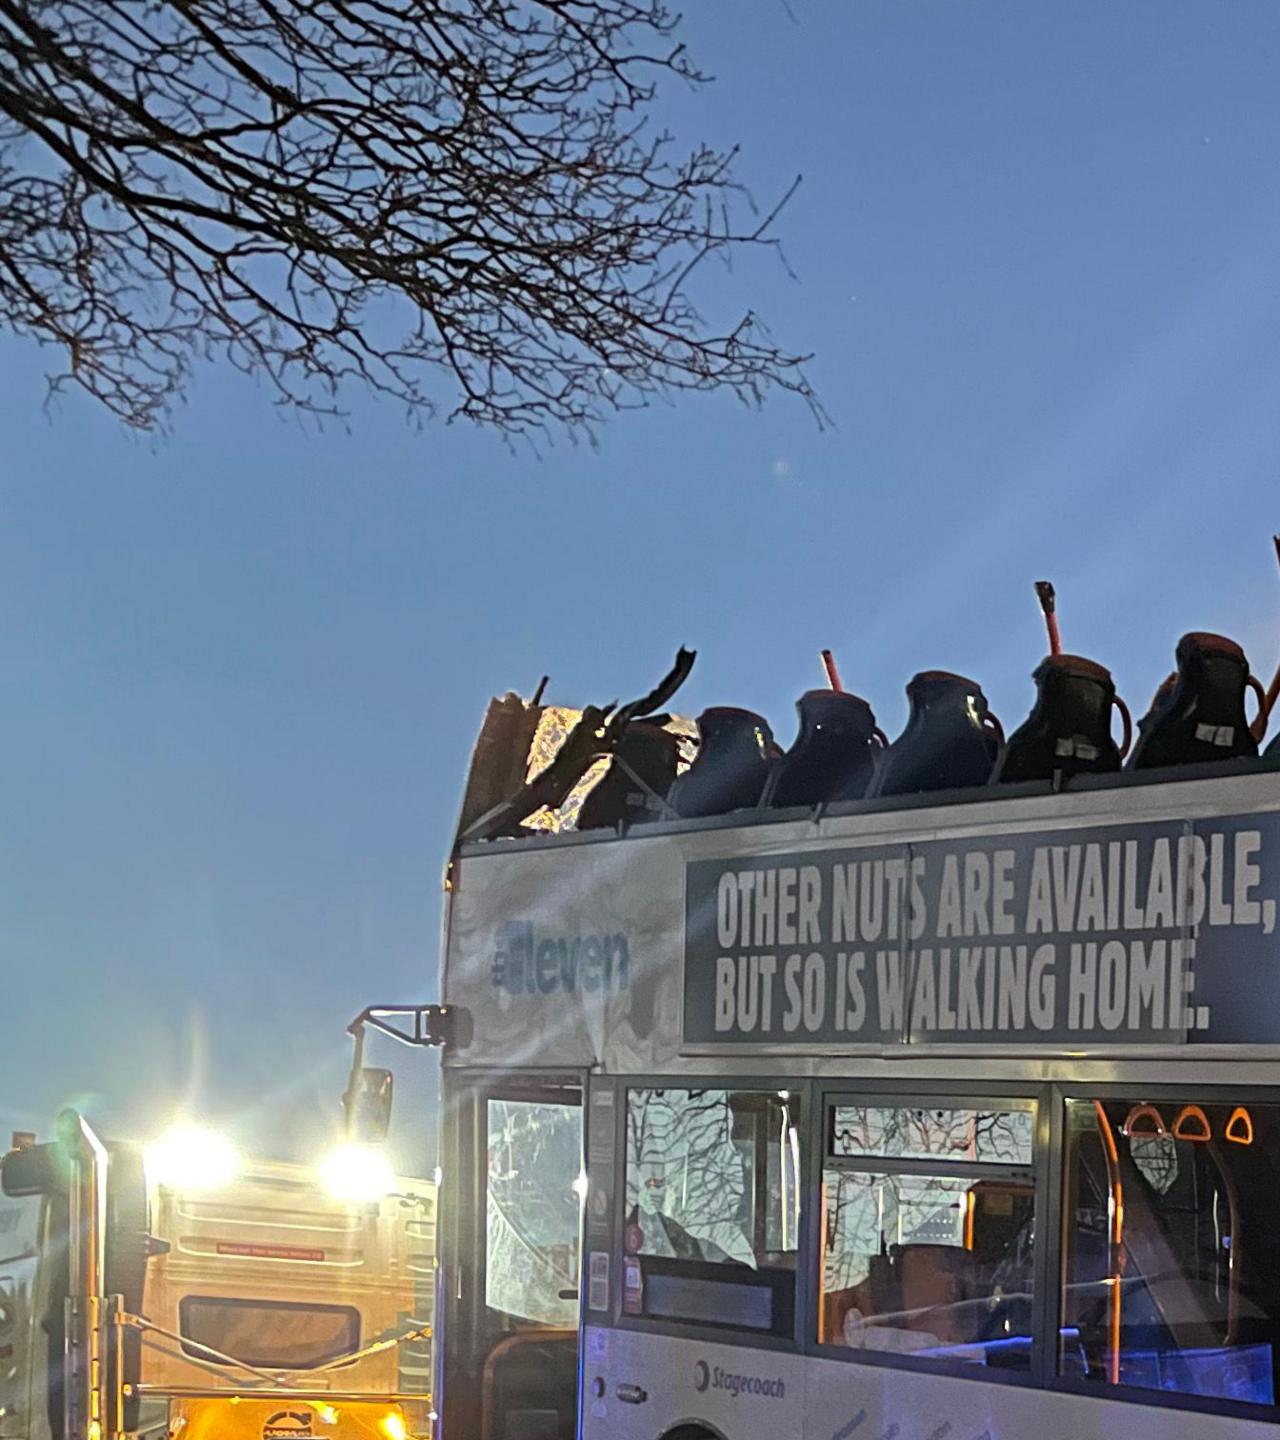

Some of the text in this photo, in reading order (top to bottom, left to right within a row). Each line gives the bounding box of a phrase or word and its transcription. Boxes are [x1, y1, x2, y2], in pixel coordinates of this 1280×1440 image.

[717, 830, 1277, 949] OTHER NUTS ARE AVAILABLE,
[715, 939, 1210, 1032] BUT SO IS WALKING HOME.
[712, 1366, 785, 1398] Stagecoach
